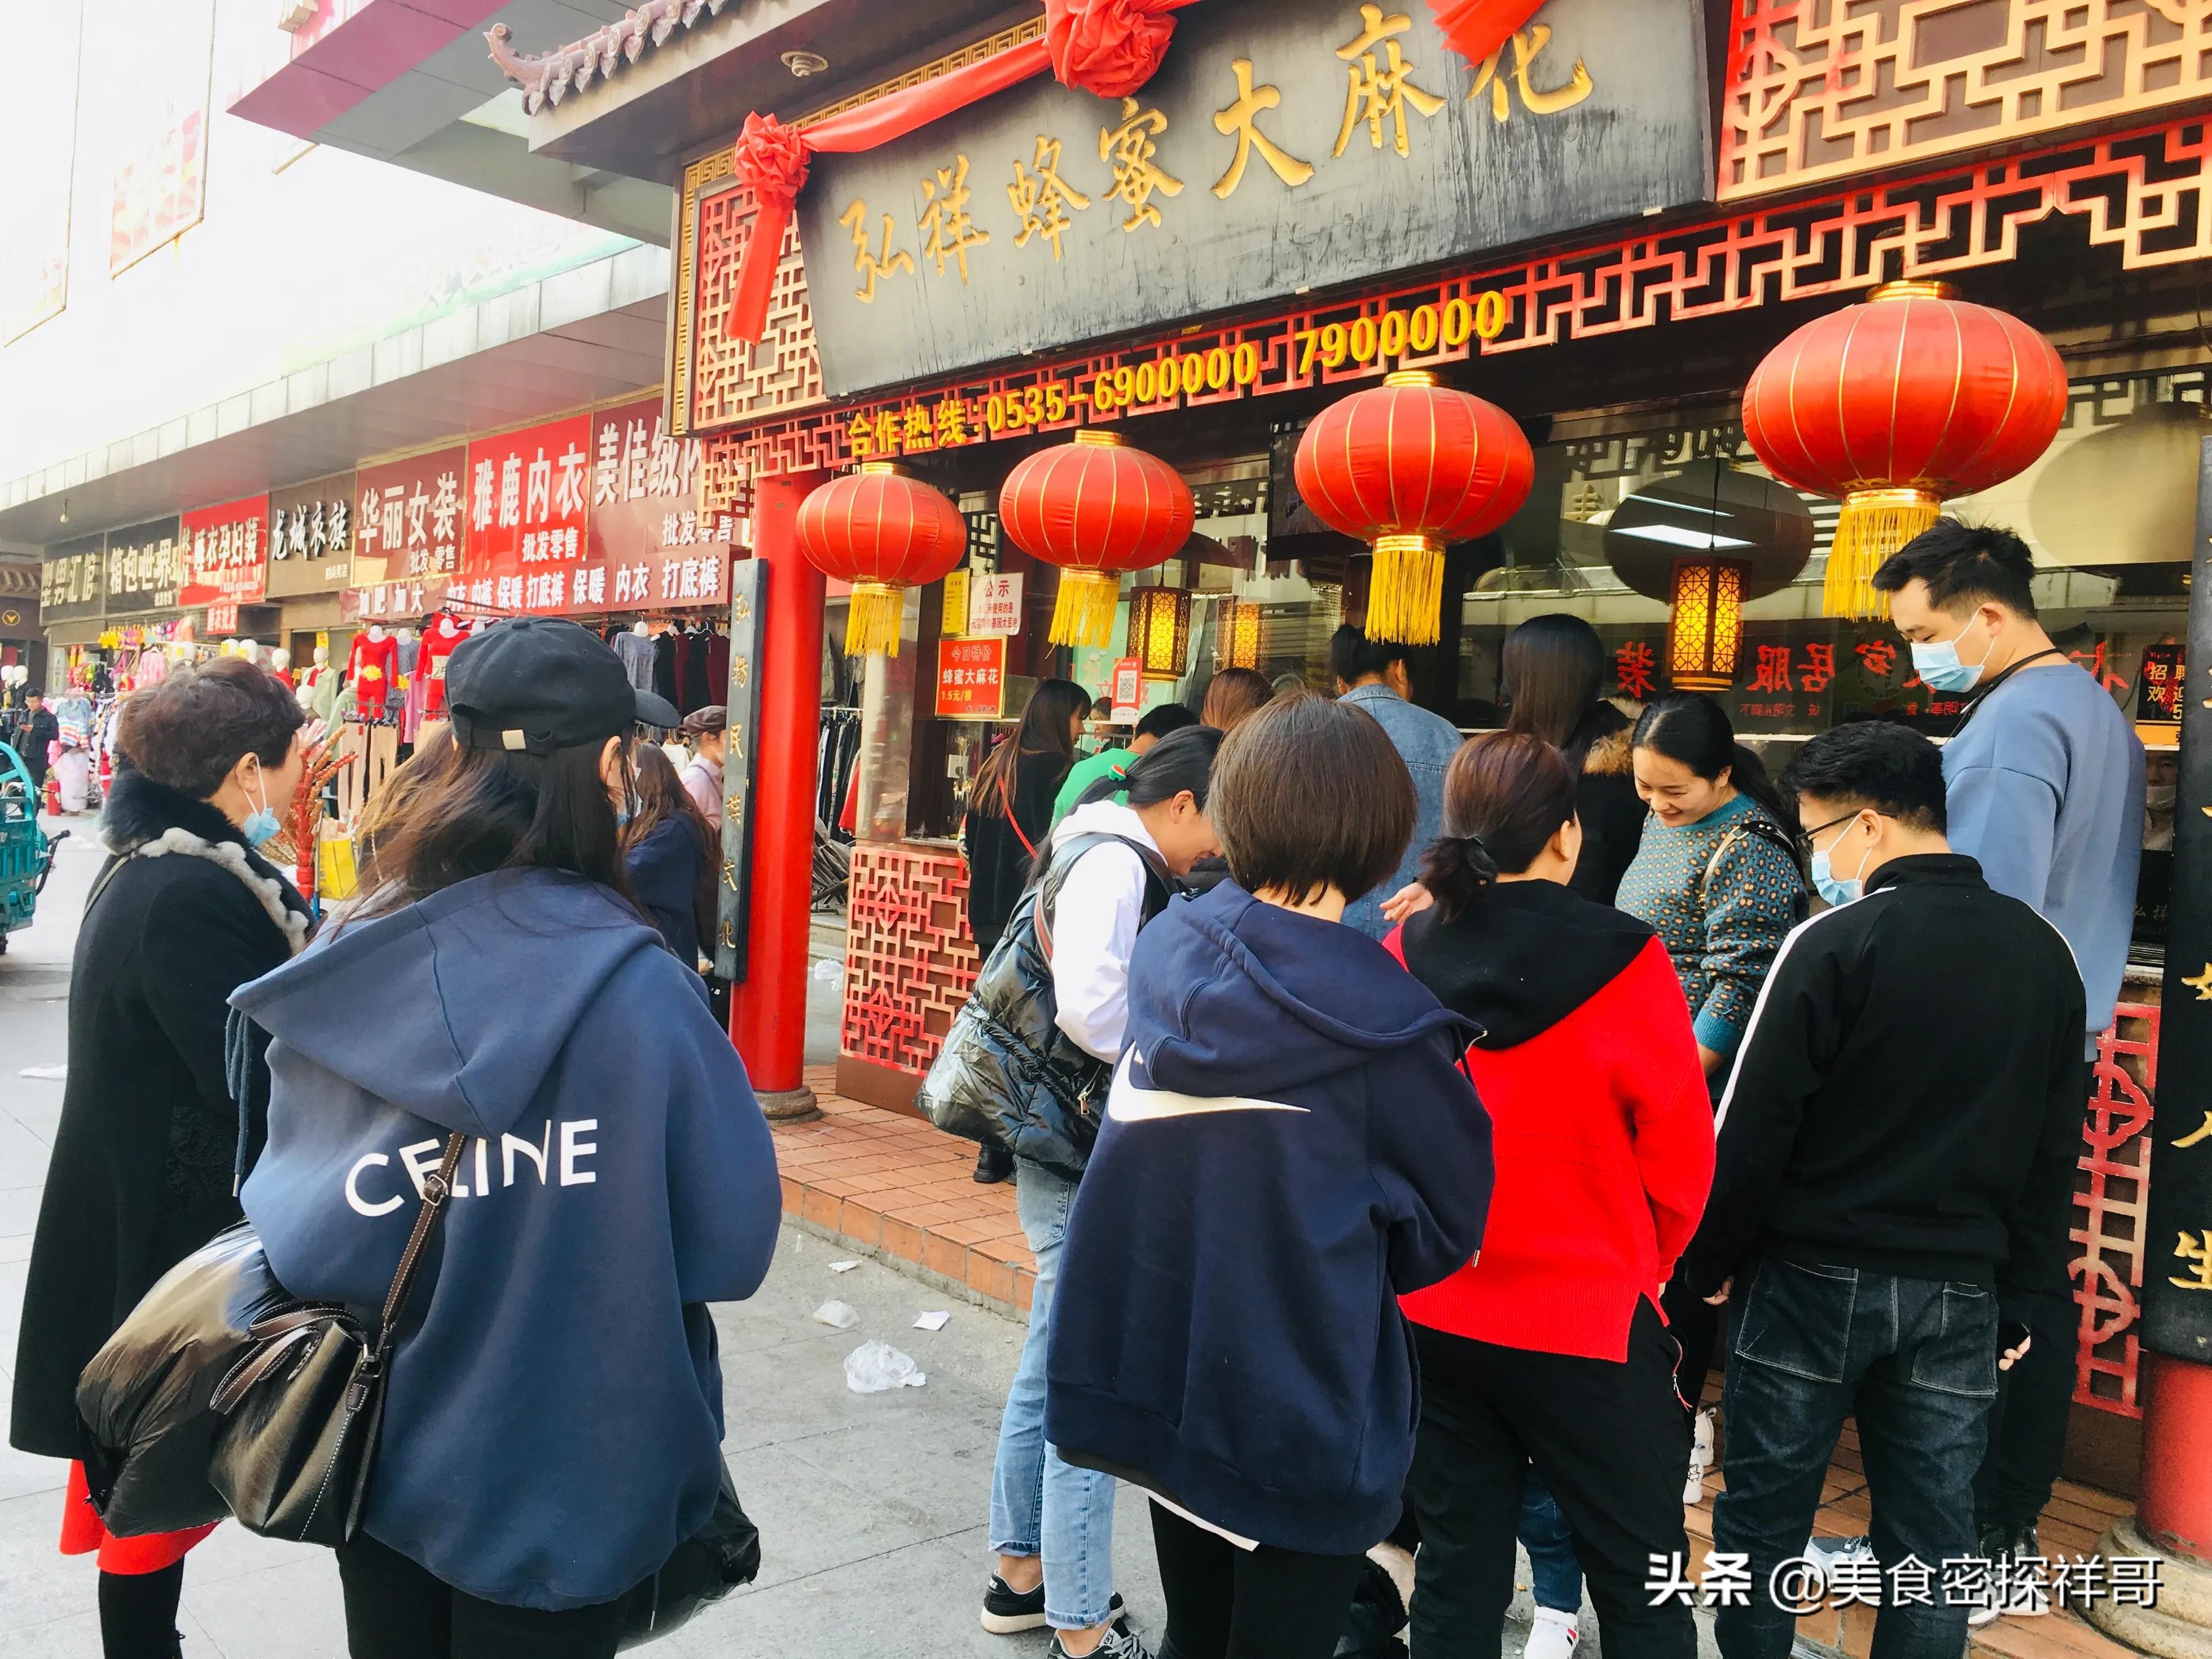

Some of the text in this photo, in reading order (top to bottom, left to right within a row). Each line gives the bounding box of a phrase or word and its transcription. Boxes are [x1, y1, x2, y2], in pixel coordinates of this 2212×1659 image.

[839, 3, 1593, 304] 弘祥蜂蜜大麻花
[1296, 291, 1507, 374] 7900000
[359, 471, 458, 552] 华丽女装
[473, 442, 586, 531] 雅鹿内衣
[110, 538, 173, 595] 箱包世界
[522, 527, 579, 562] 批发零售
[573, 565, 606, 605] 保暖
[614, 561, 651, 603] 内衣
[662, 555, 721, 600] 打底裤
[984, 580, 1010, 598] 公示
[942, 667, 998, 686] 蜂蜜大麻花
[951, 645, 992, 662] 今日特价
